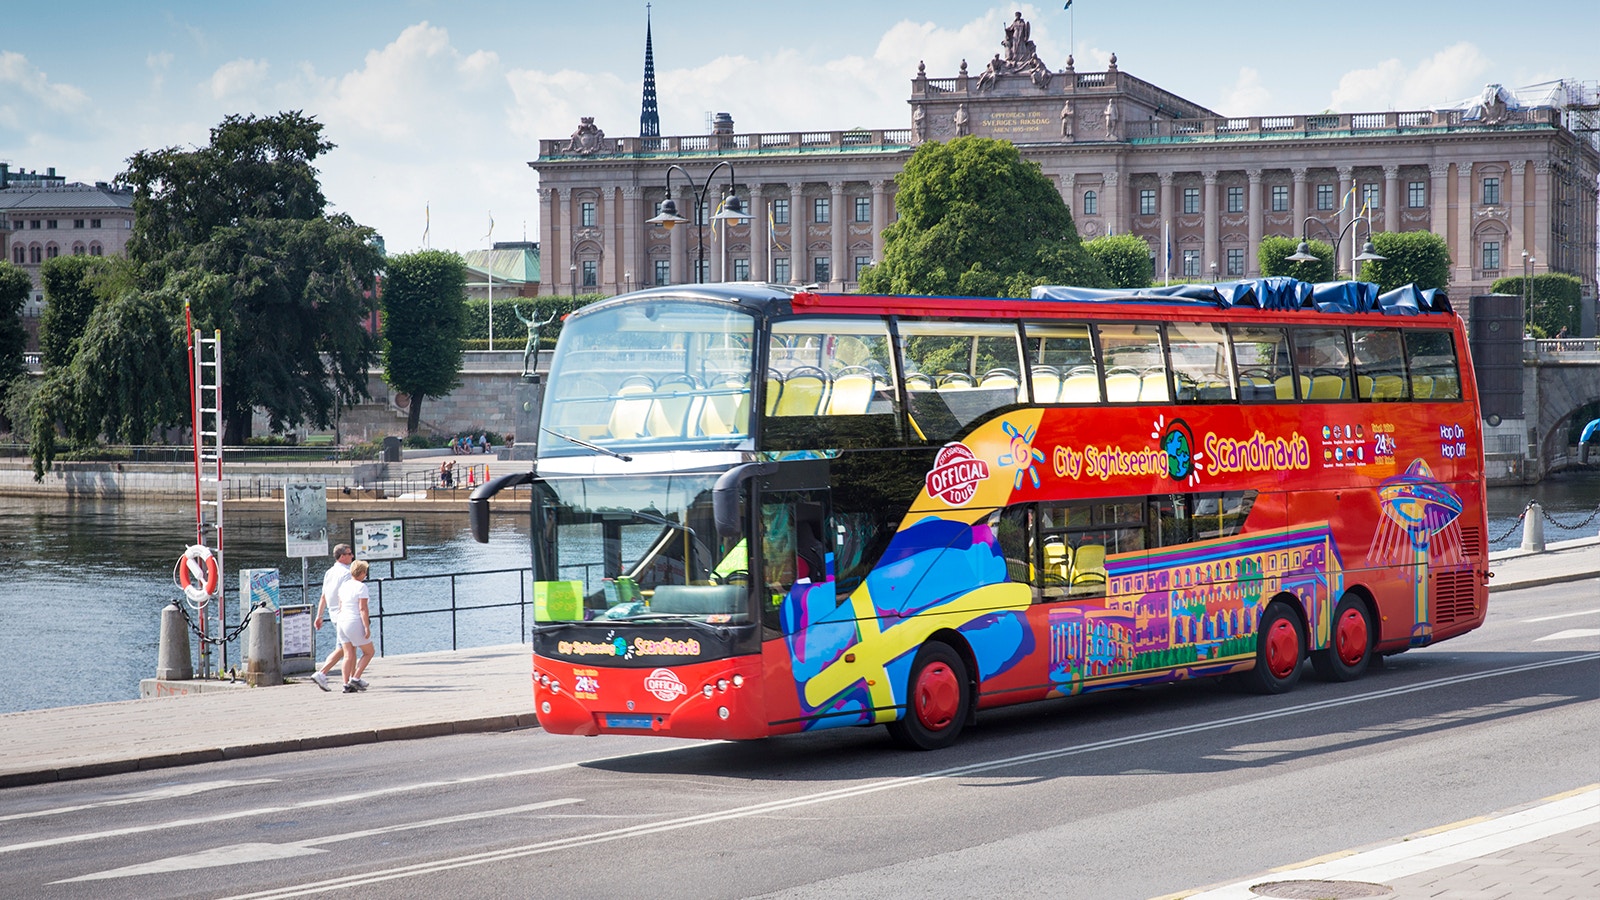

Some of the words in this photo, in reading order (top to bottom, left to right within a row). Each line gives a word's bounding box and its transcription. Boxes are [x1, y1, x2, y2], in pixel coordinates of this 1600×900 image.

[1440, 424, 1454, 440] Hop
[1454, 423, 1465, 439] On
[1053, 445, 1082, 480] City
[1085, 445, 1170, 481] Sightseeing
[1204, 430, 1310, 476] Scandinavia
[1441, 442, 1455, 459] Hop
[1455, 441, 1466, 457] Off
[931, 463, 987, 492] OFFICIAL
[949, 482, 974, 502] TOUR
[634, 637, 701, 656] Scandinavia
[648, 680, 684, 692] OFFICIAL
